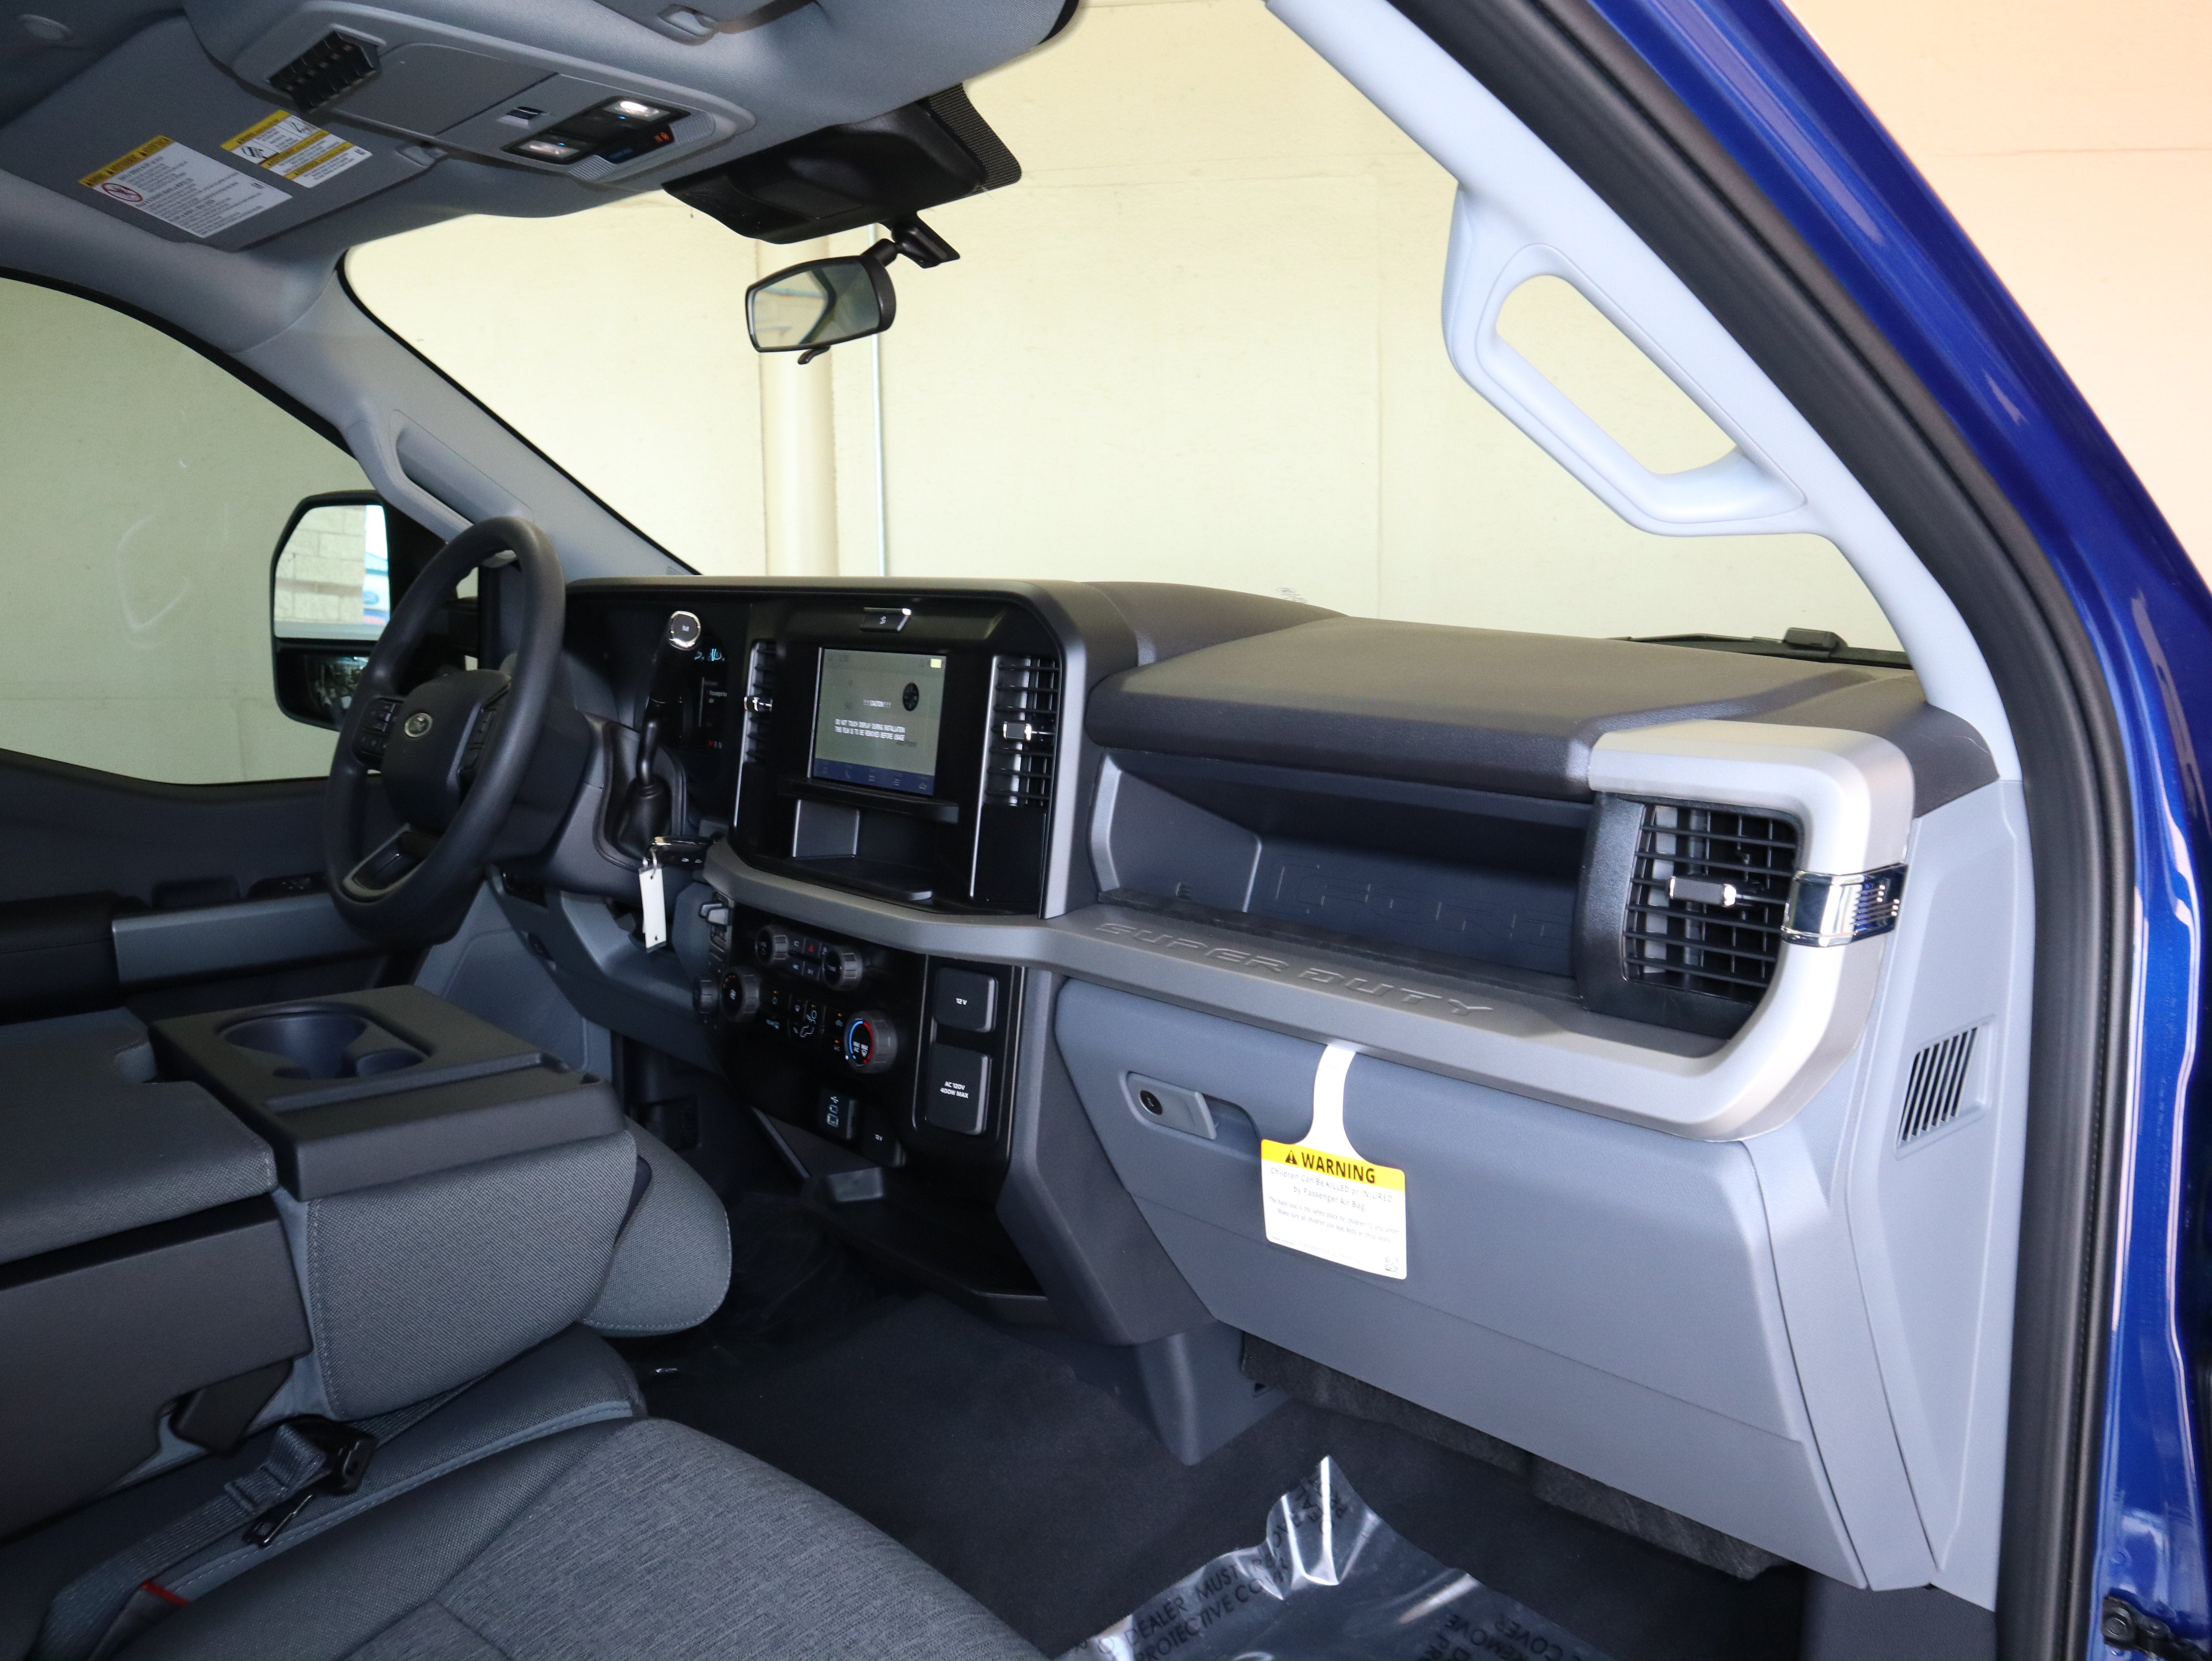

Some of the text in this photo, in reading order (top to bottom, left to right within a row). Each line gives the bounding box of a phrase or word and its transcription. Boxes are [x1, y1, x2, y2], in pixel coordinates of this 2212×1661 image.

[1095, 923, 1493, 1016] SUPER DUTY
[940, 1087, 969, 1099] 400W MAX
[1271, 1167, 1299, 1180] Children
[1301, 1175, 1314, 1183] Can
[1316, 1178, 1324, 1186] Be
[1326, 1181, 1349, 1193] KILLED
[1361, 1189, 1392, 1202] INJURED
[1301, 1151, 1375, 1184] WARNING
[1294, 1186, 1302, 1195] by
[1304, 1188, 1338, 1203] Passenger
[1352, 1200, 1365, 1212] Bag
[1124, 1596, 1188, 1646] DEALER
[1194, 1563, 1240, 1603] MUST
